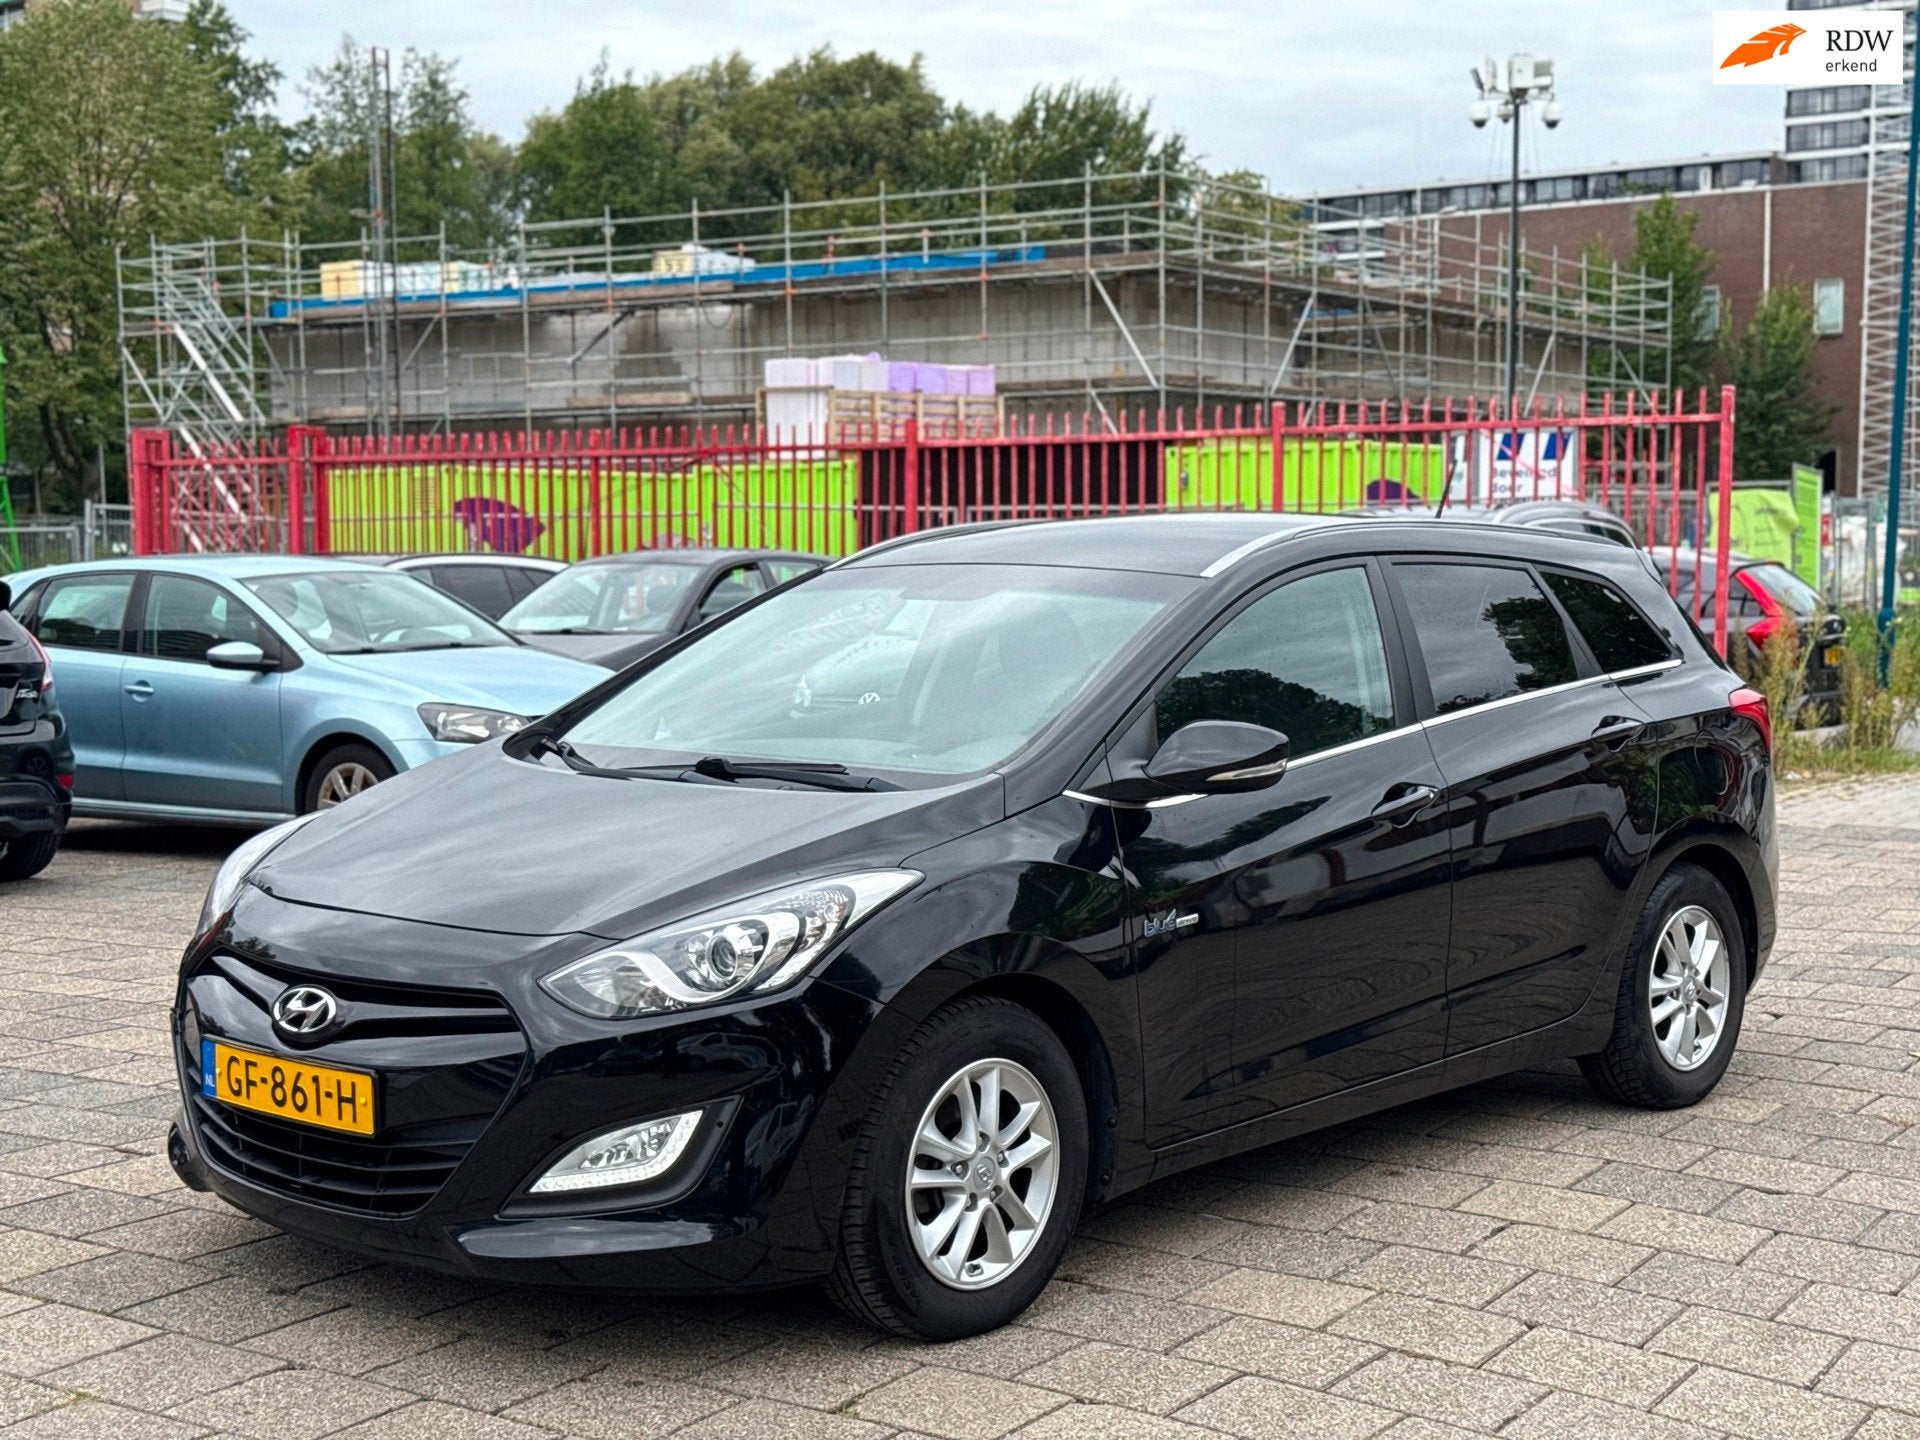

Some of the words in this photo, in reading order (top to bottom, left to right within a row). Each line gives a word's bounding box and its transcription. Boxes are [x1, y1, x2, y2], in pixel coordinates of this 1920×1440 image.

[1144, 914, 1176, 937] blue
[205, 1073, 215, 1087] NL
[226, 1055, 357, 1124] GF-861-H
